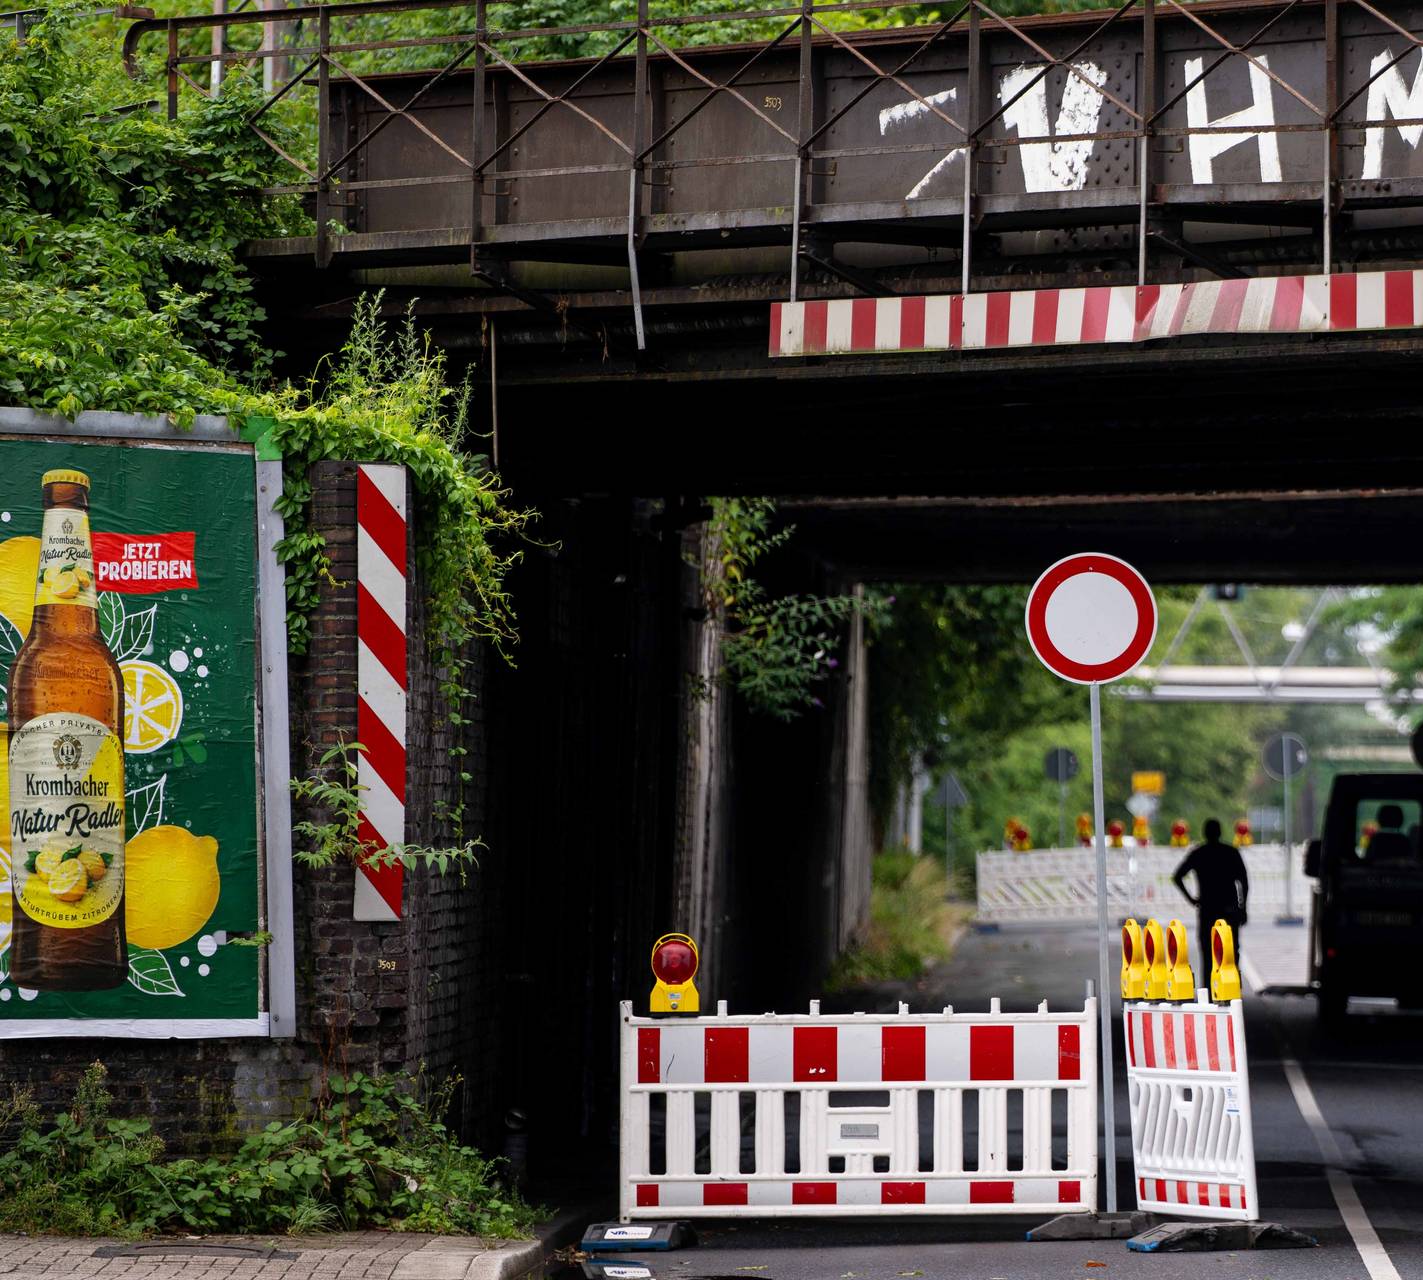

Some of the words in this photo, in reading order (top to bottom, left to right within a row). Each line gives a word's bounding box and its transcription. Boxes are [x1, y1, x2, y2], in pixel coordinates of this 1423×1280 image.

[122, 543, 162, 559] JETZT
[98, 560, 192, 581] PROBIEREN
[26, 773, 109, 796] Krombacher
[12, 807, 65, 842] Natur
[64, 802, 124, 838] Radler
